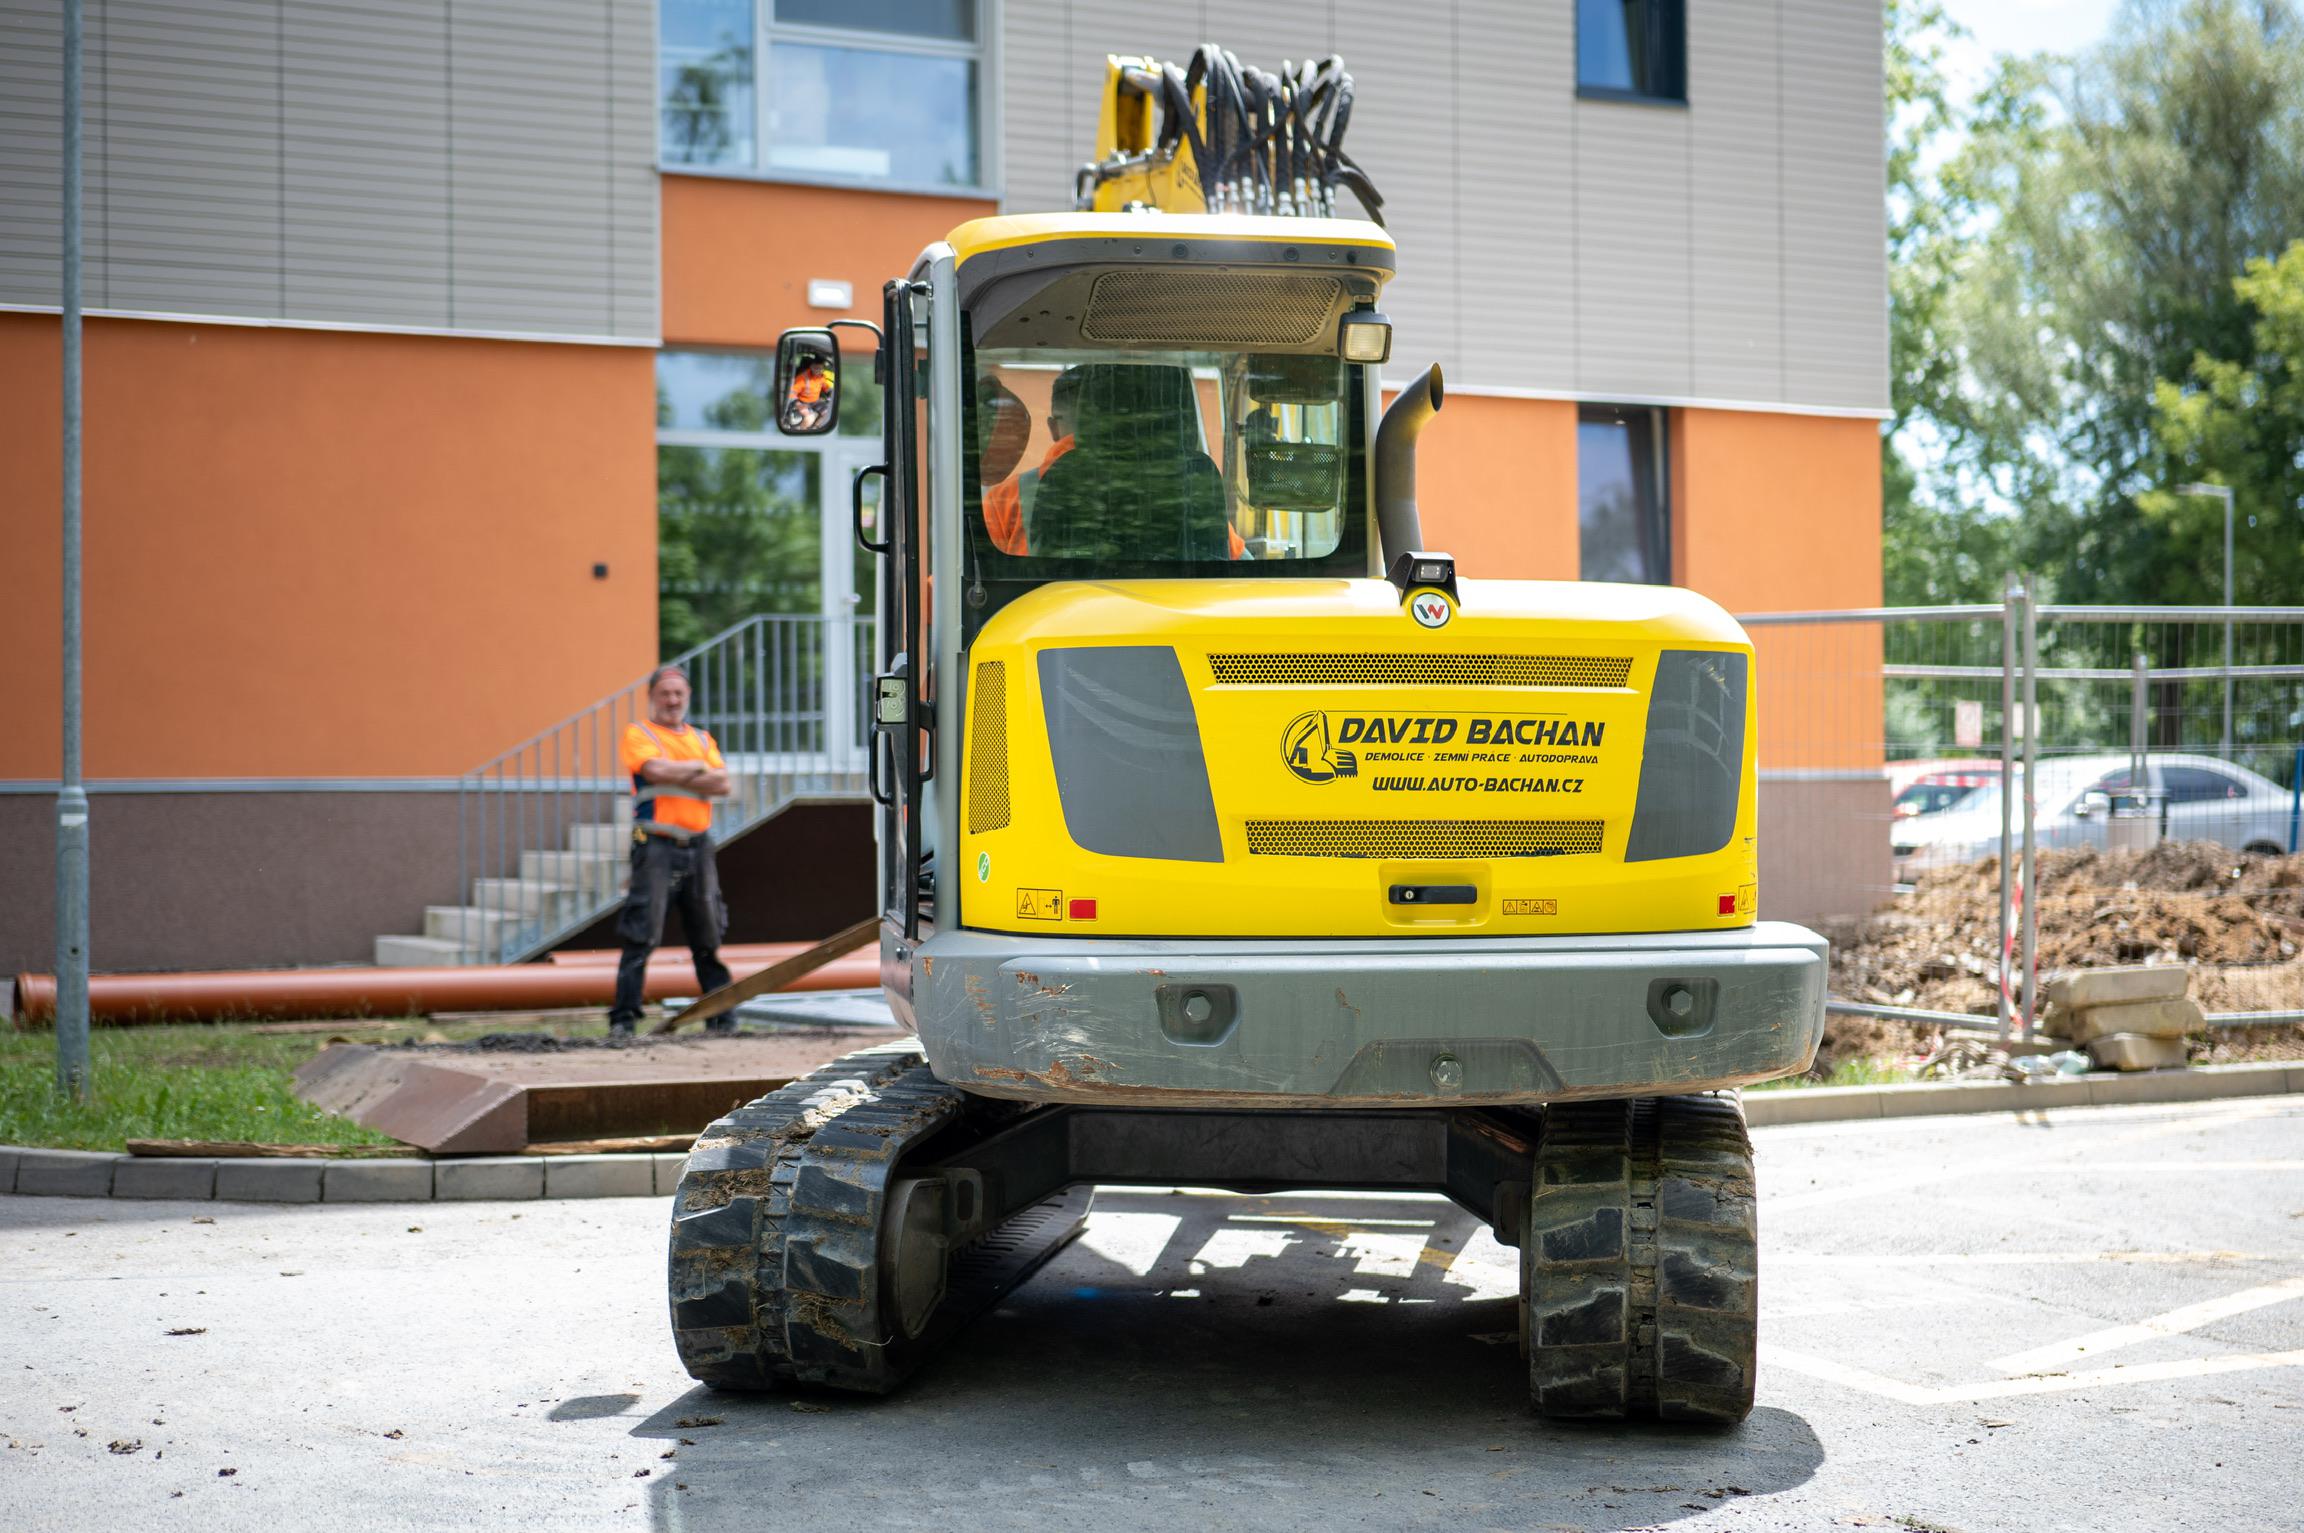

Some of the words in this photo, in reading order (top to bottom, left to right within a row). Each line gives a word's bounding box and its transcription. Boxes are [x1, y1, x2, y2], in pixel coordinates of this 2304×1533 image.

[1338, 718, 1458, 744] DAVID
[1465, 719, 1606, 747] BACHAN
[1364, 752, 1425, 761] DEMOLICE
[1519, 754, 1599, 764] AUTODOPRAVA
[1372, 777, 1585, 793] WWW.AUTO-BACHAN.CZ
